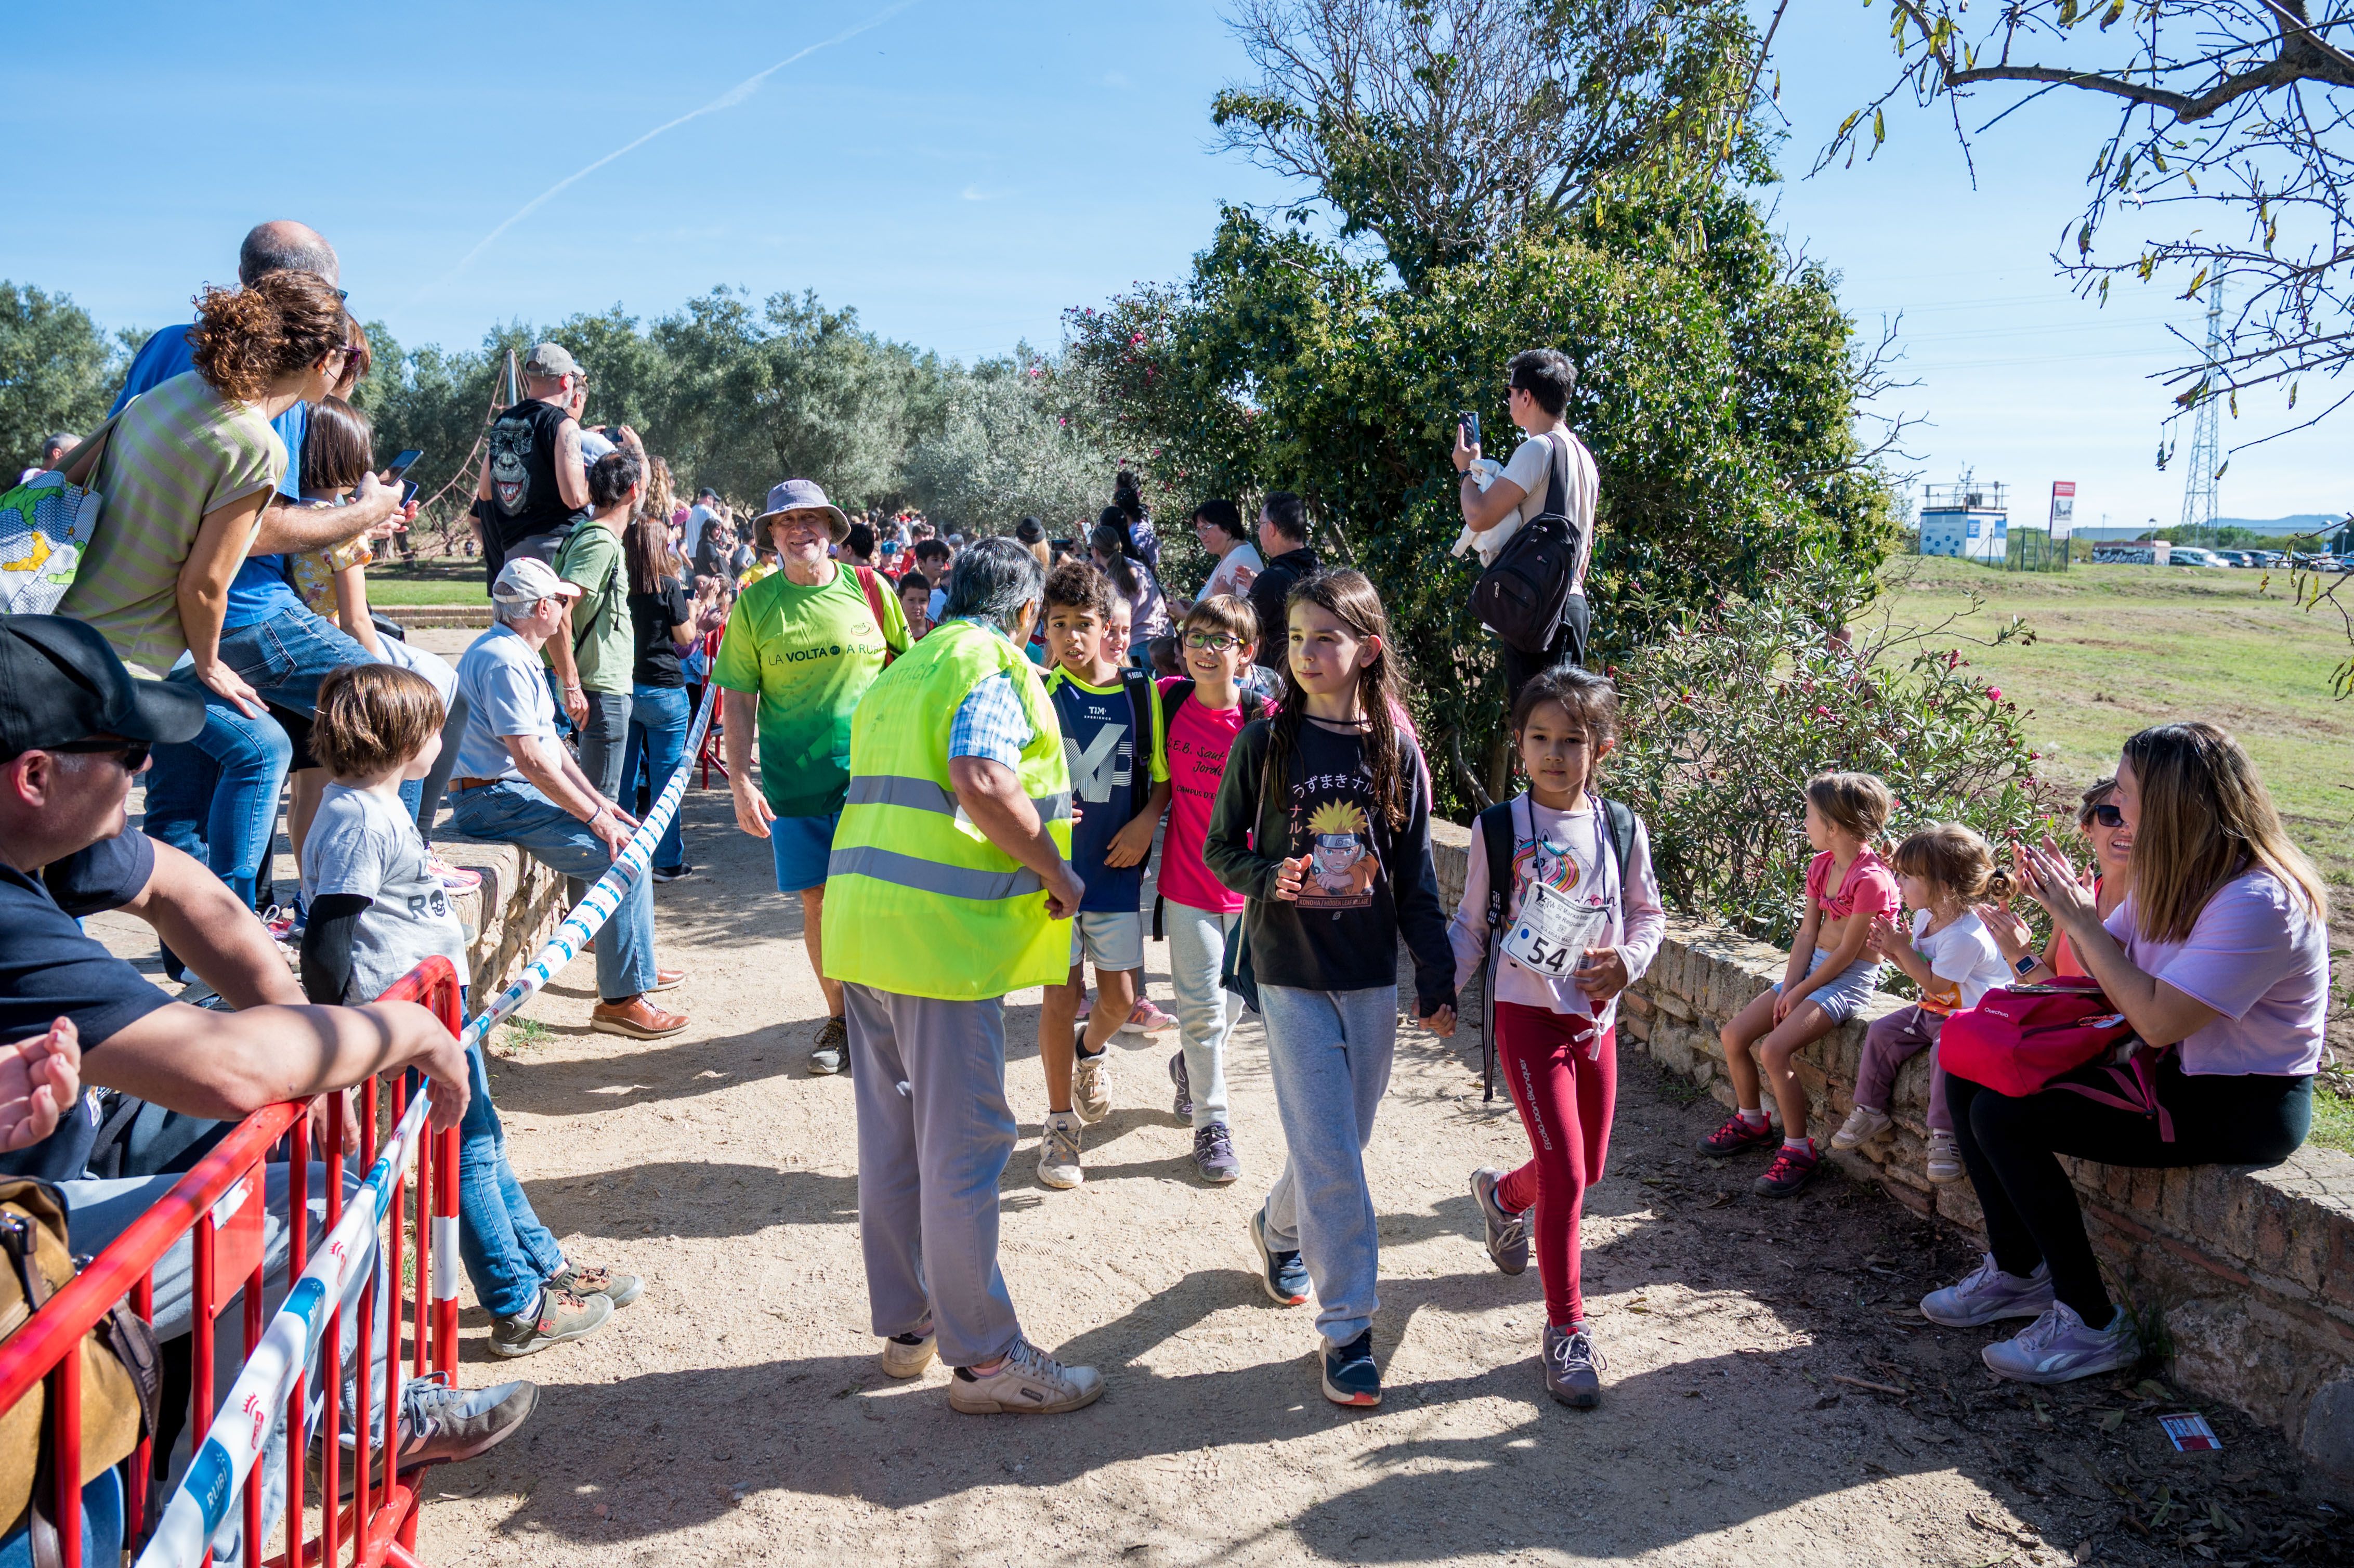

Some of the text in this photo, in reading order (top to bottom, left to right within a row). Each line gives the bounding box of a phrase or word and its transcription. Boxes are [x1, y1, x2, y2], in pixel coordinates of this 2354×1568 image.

[768, 654, 784, 666] LA
[786, 647, 828, 662] VOLTA
[846, 644, 855, 654] A
[1193, 761, 1223, 776] Jordi
[1176, 785, 1202, 797] CAMPUS
[1292, 773, 1375, 799] うずまきナル
[1289, 804, 1303, 851] ナルト
[1353, 897, 1369, 905] VILLAGE
[1563, 908, 1579, 919] Marxa
[1548, 931, 1561, 940] ARIAS
[1527, 936, 1568, 972] 54
[1984, 1007, 2009, 1018] Quechua
[1519, 1057, 1552, 1151] Escola Joan Blanquer
